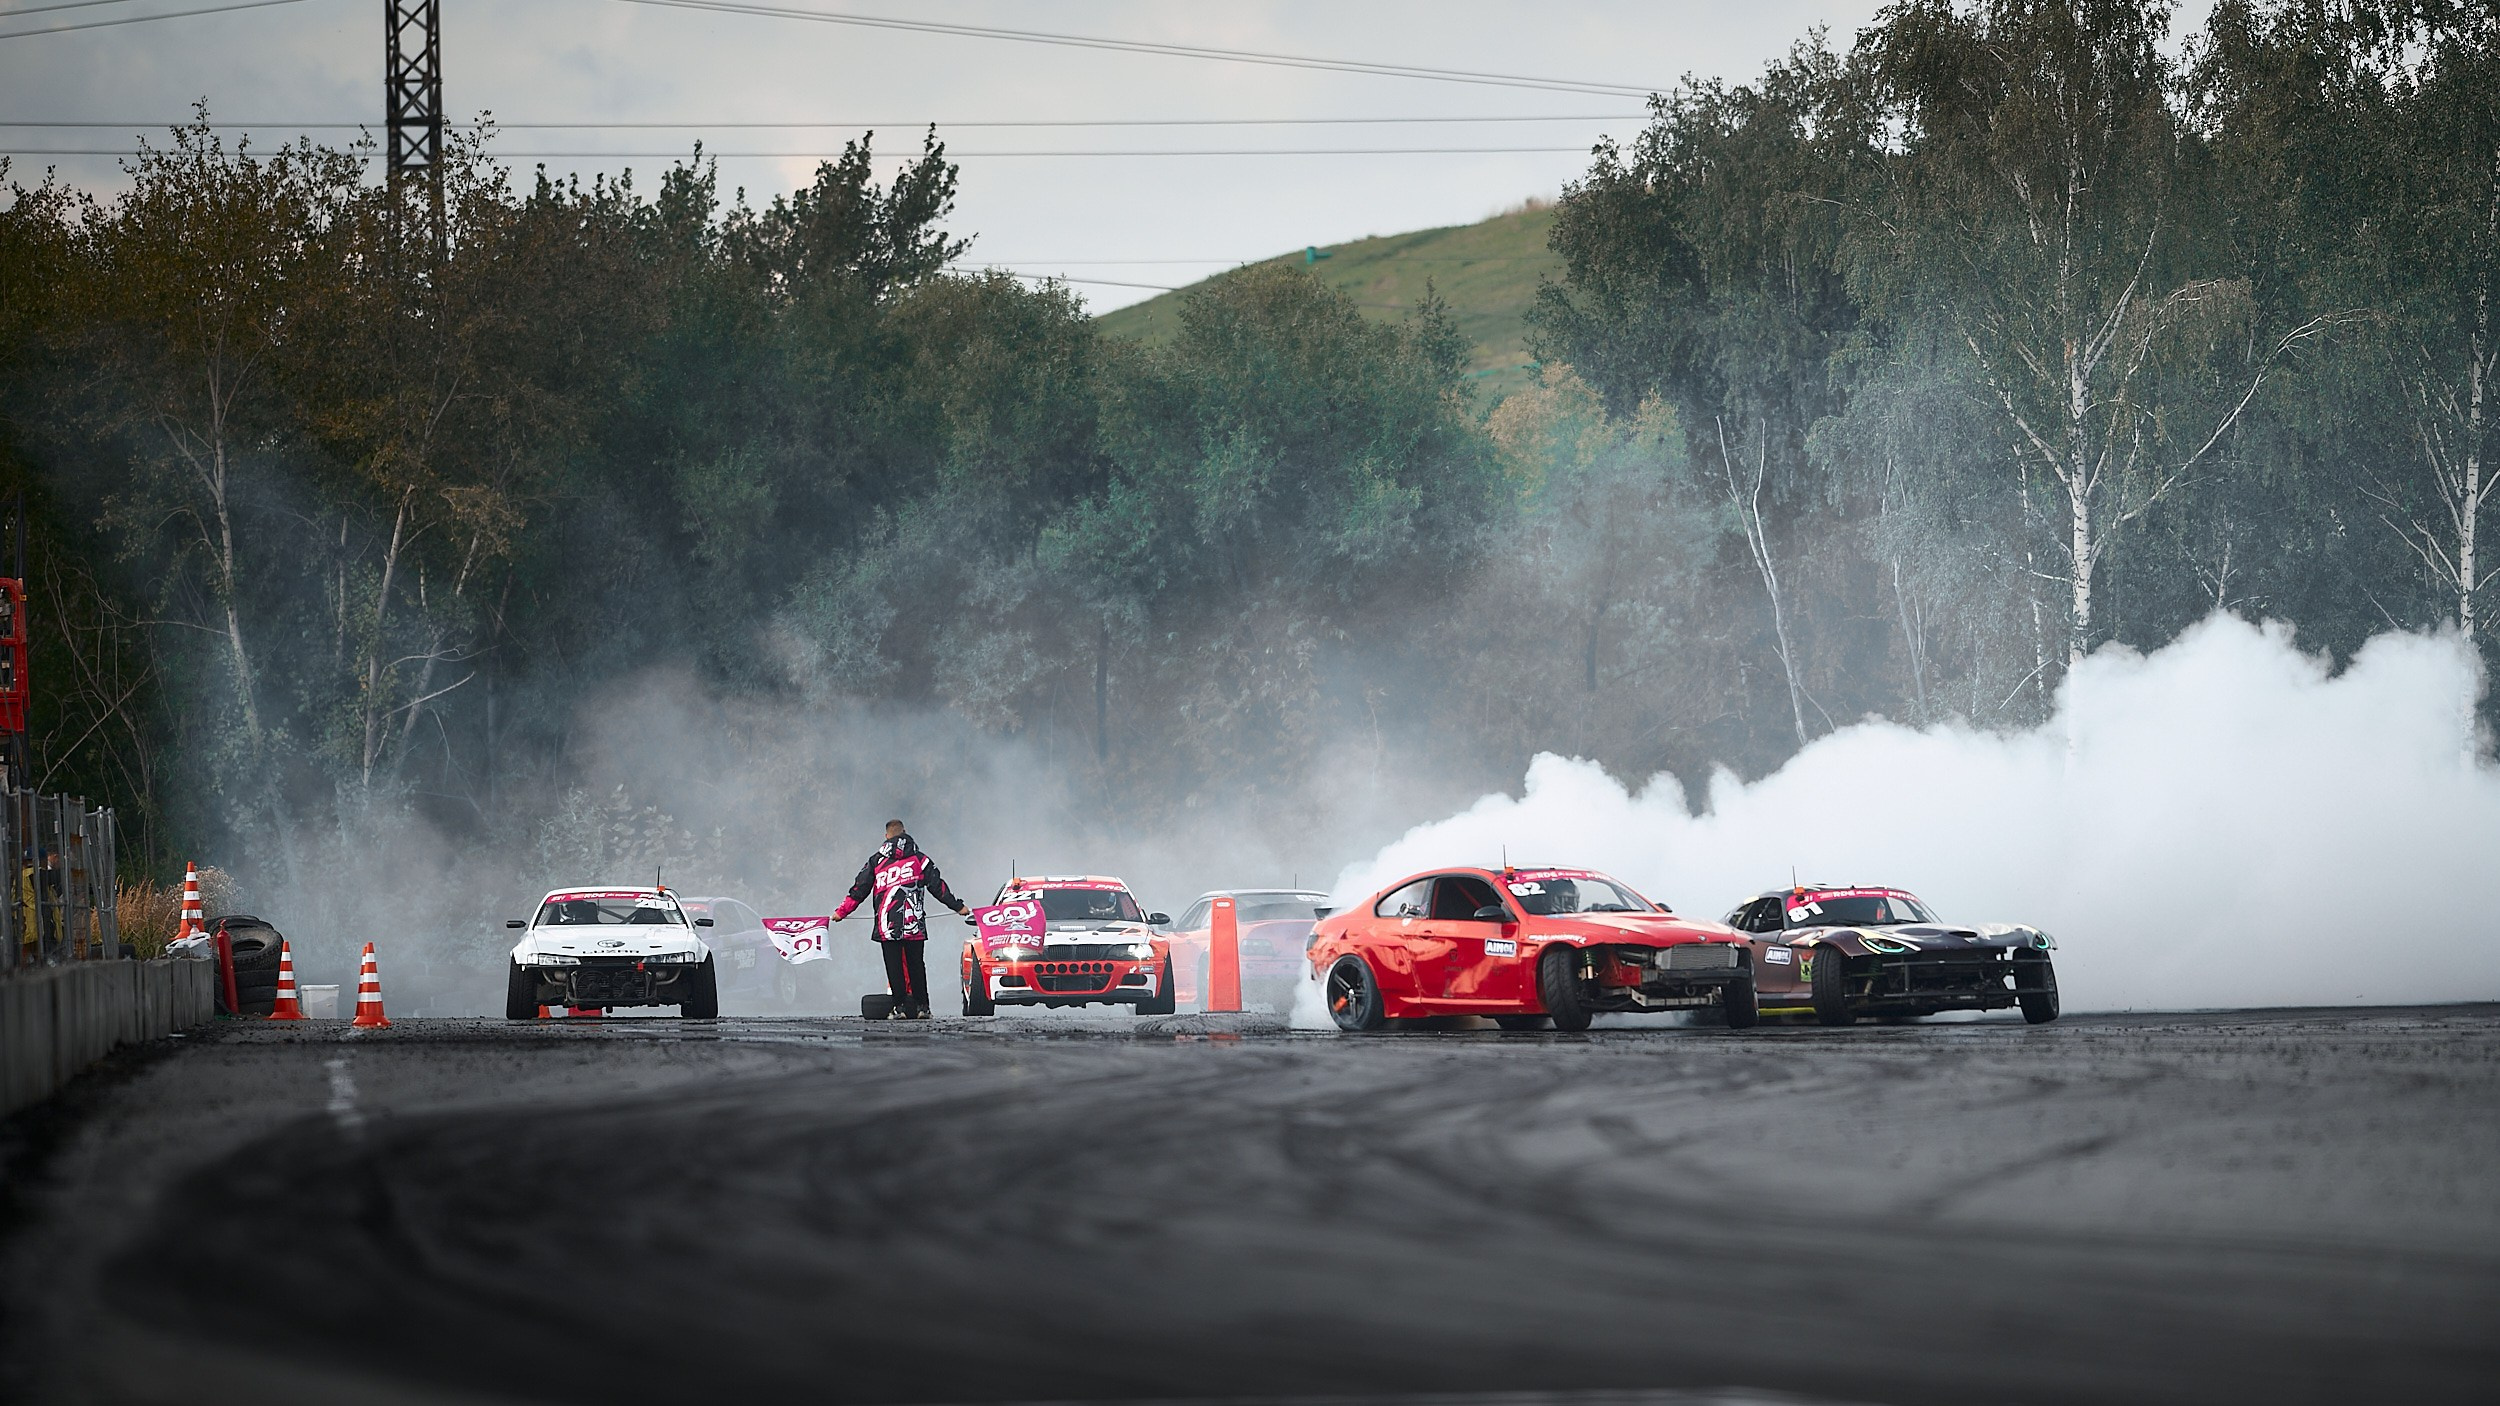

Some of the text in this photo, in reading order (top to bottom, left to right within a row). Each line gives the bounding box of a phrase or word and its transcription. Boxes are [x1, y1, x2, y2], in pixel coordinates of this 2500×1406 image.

[876, 861, 915, 889] RDS
[1003, 889, 1044, 902] 221
[1507, 882, 1546, 897] 82
[1788, 901, 1824, 922] 81
[773, 920, 819, 931] RDS
[1009, 934, 1042, 947] RDS
